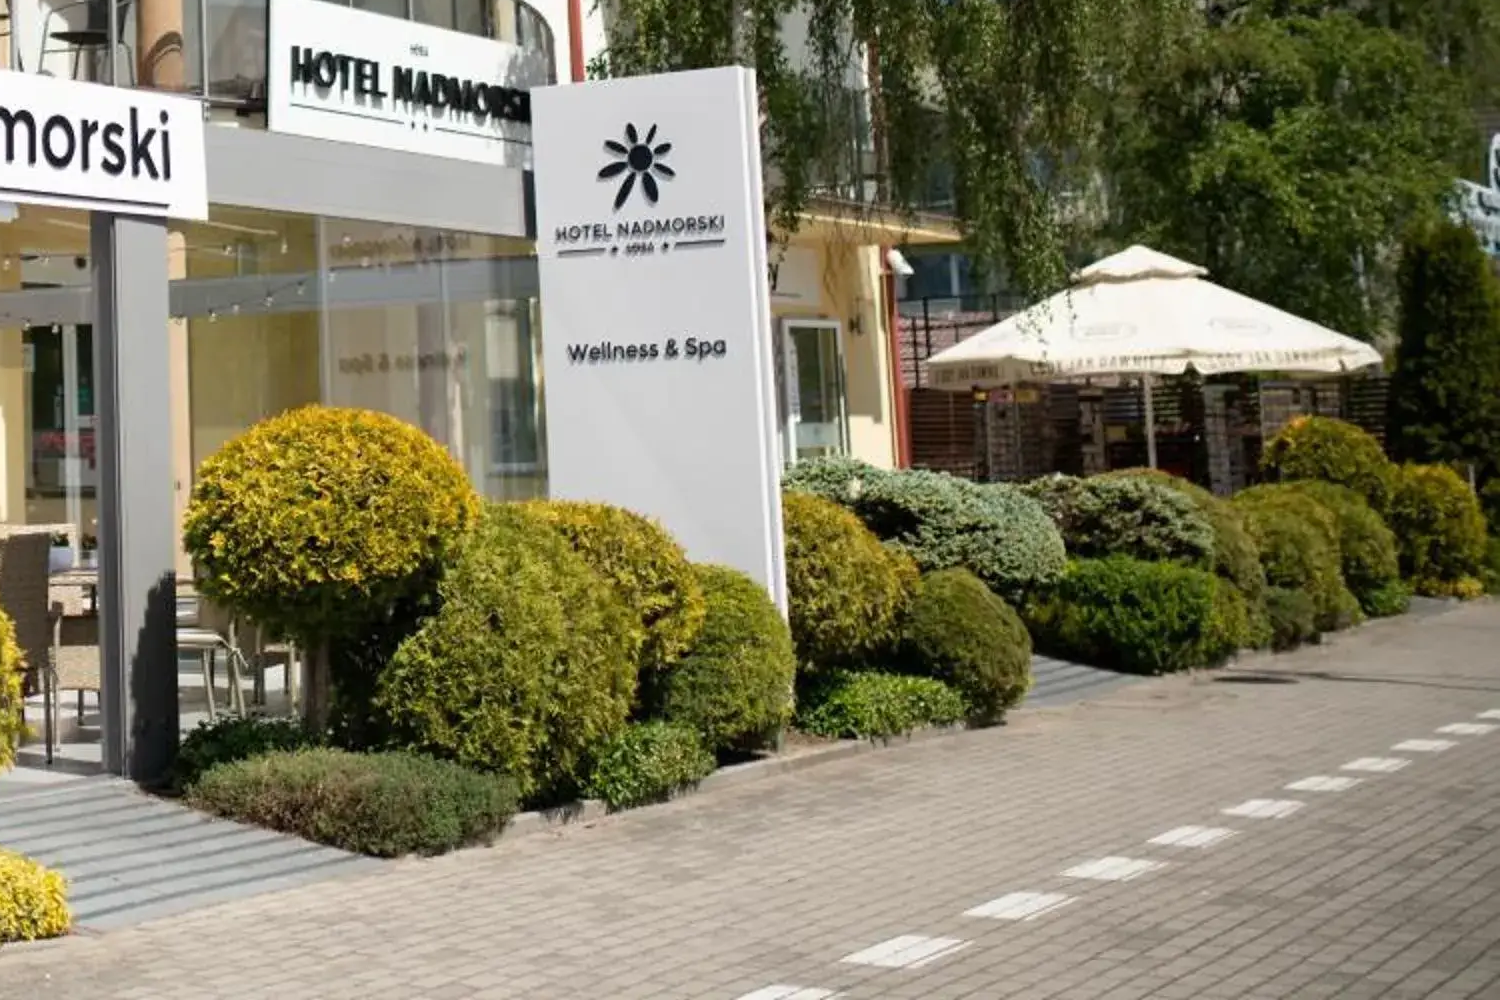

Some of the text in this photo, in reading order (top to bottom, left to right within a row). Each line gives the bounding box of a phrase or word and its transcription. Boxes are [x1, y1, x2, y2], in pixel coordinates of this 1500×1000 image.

[291, 46, 531, 123] HOTEL NADMORS
[555, 215, 725, 240] HOTEL NADMORSKI
[568, 337, 727, 362] Wellness & Spa
